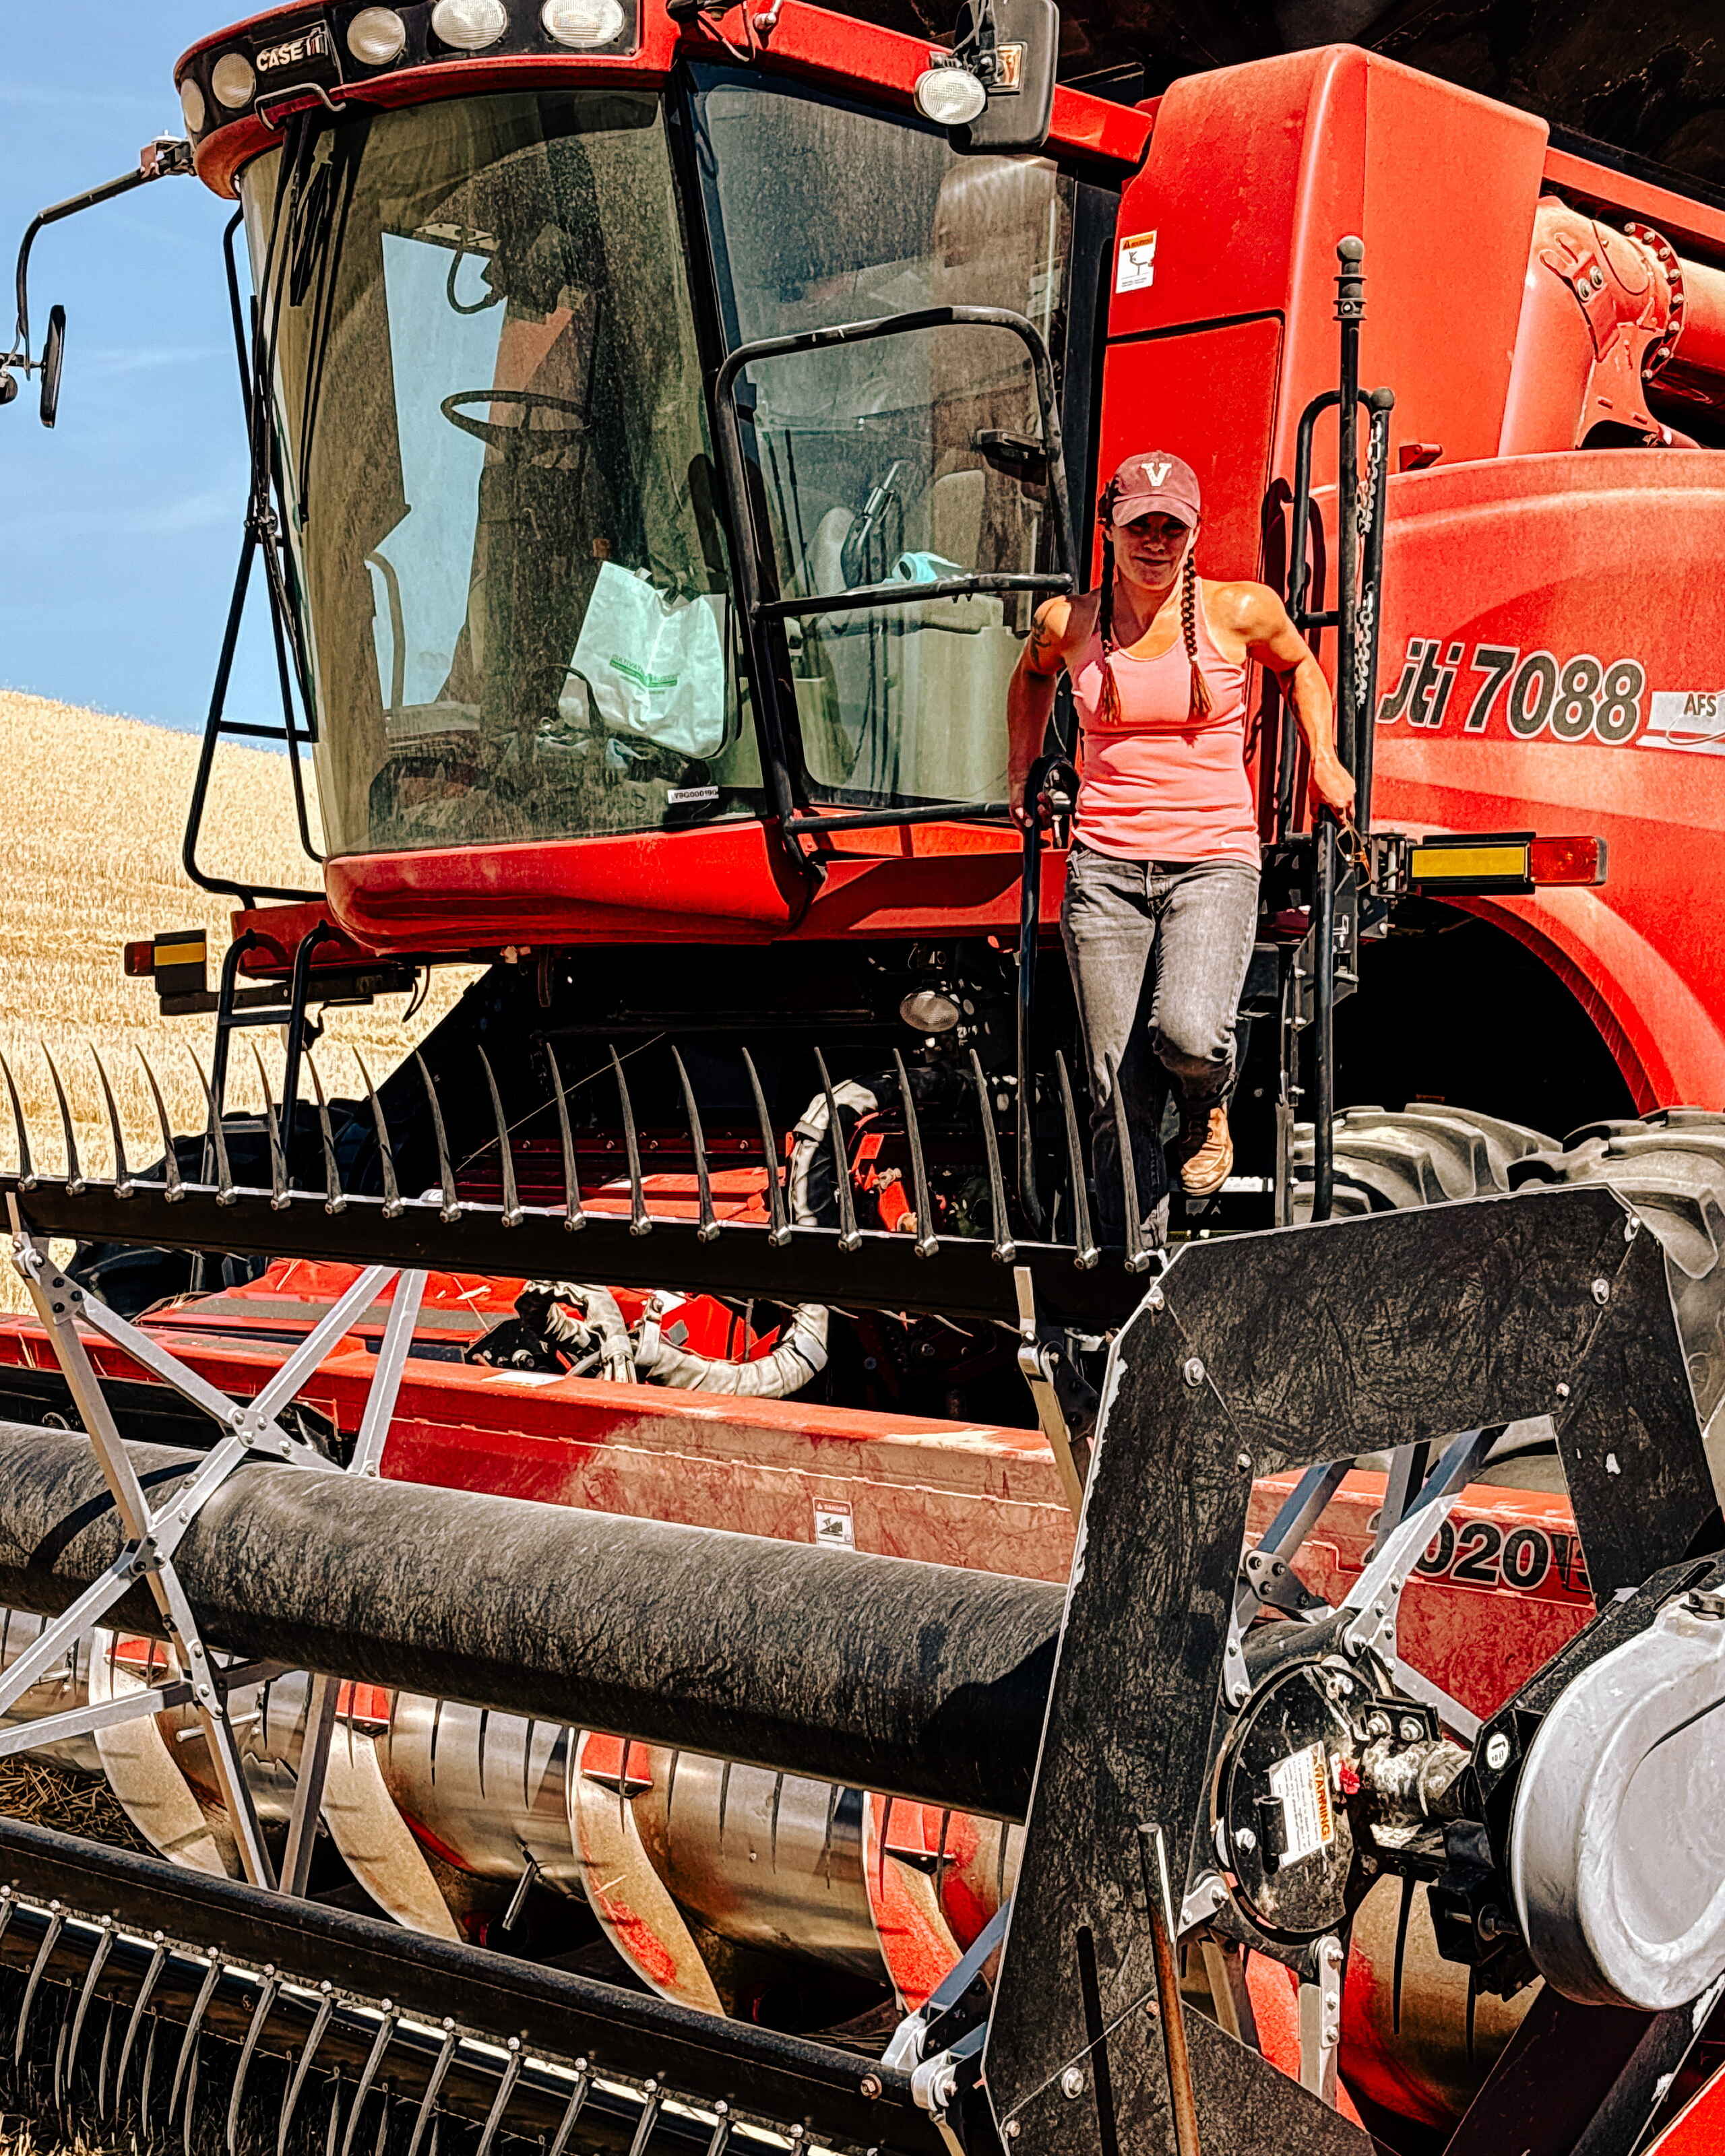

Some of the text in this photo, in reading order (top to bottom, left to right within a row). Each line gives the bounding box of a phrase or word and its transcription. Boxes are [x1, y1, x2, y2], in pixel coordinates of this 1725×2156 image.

[257, 41, 304, 71] CASE
[1140, 463, 1172, 487] V
[1464, 643, 1645, 745] 7088
[1683, 693, 1717, 717] AFS
[1314, 1763, 1331, 1837] WARNING
